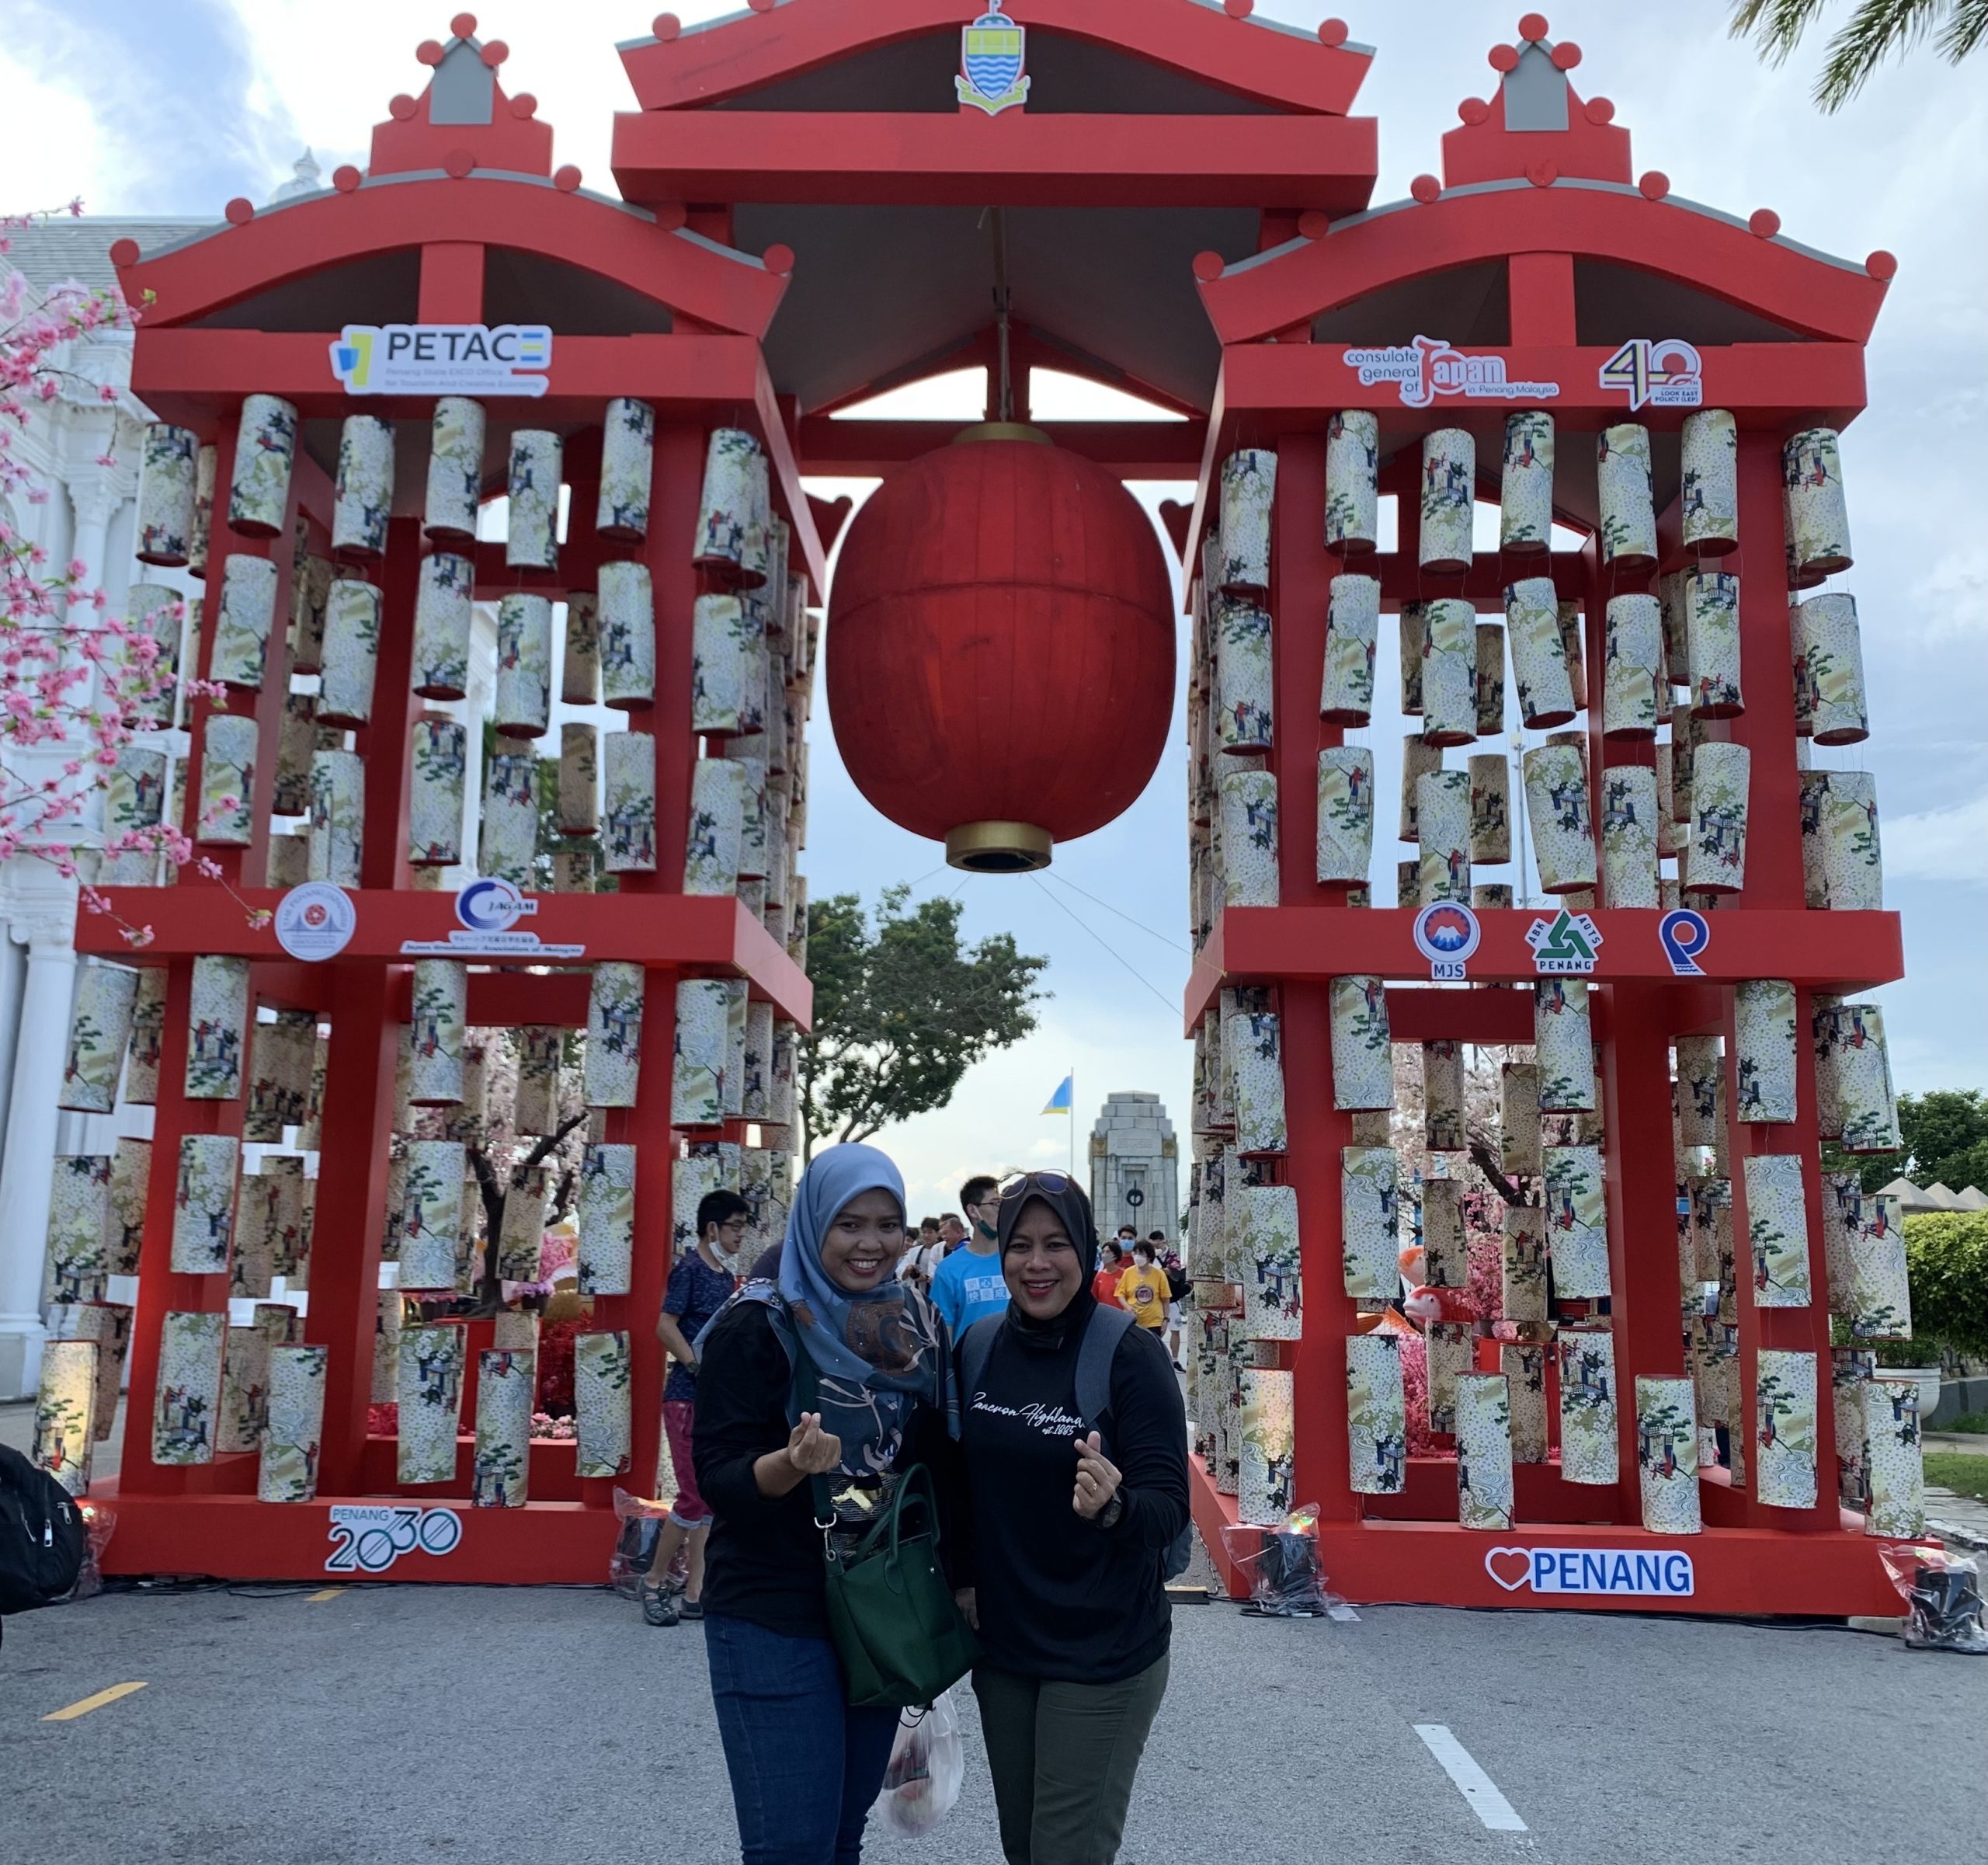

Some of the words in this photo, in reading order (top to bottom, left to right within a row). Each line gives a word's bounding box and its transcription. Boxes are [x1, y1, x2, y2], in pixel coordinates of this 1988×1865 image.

[388, 332, 544, 361] PETACE
[1347, 350, 1419, 363] consulate
[1363, 366, 1420, 381] general
[1416, 339, 1503, 402] Japan
[1405, 382, 1420, 393] of
[1479, 384, 1514, 395] Penang
[1516, 384, 1557, 395] Malaysia
[488, 901, 534, 913] JAGAM
[1528, 922, 1545, 943] ABK
[1578, 917, 1600, 944] AOTS
[1434, 964, 1464, 977] MJS
[1540, 961, 1591, 970] PENANG
[332, 1508, 388, 1521] PENANG
[328, 1511, 458, 1568] 2030
[1534, 1552, 1690, 1592] PENANG
